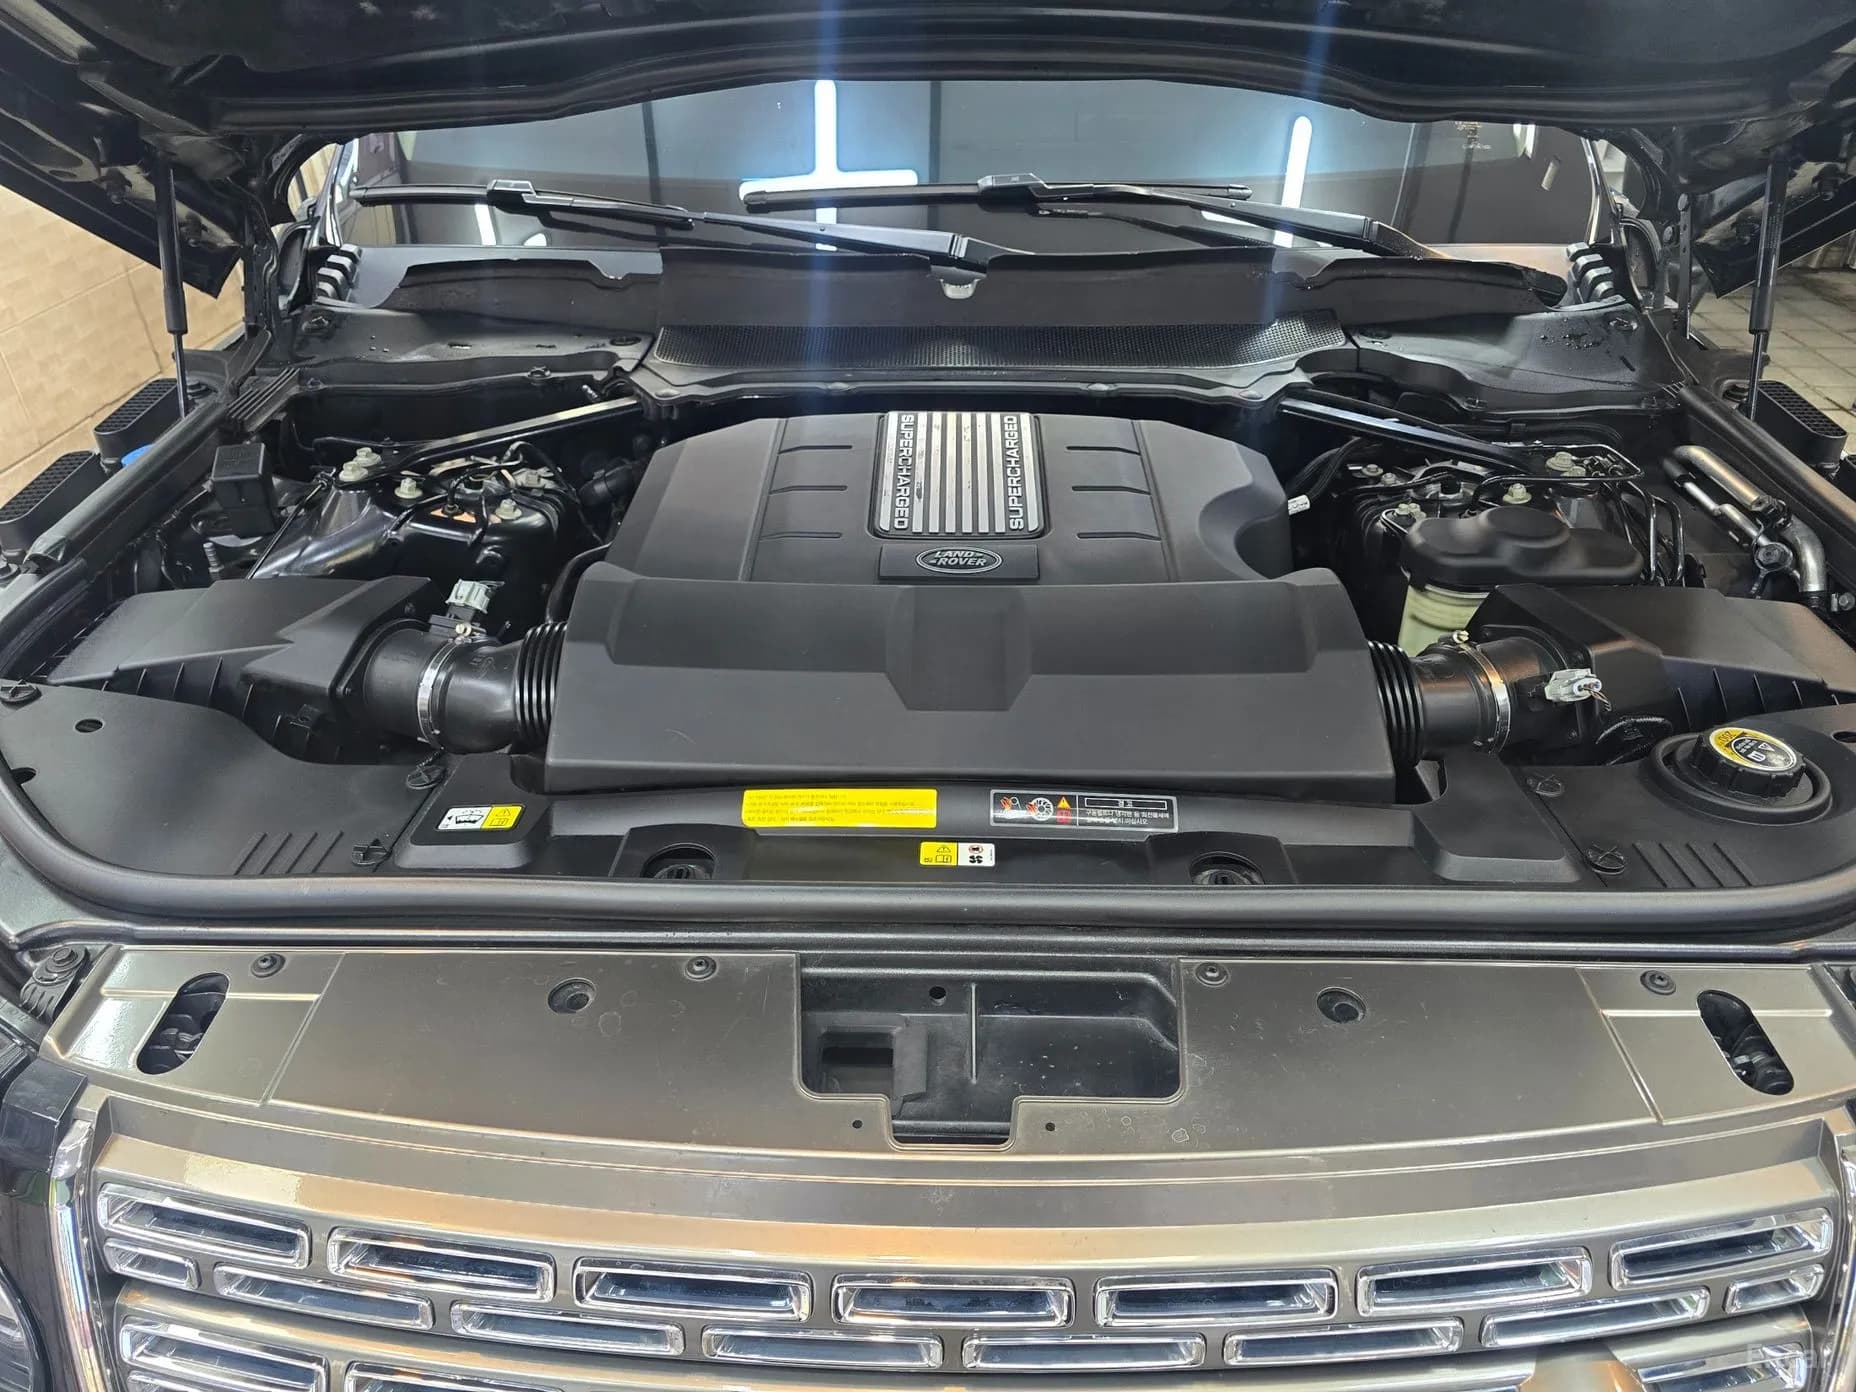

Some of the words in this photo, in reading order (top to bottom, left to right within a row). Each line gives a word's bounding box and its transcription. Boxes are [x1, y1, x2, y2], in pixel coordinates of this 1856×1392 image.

[893, 414, 915, 530] SUPERCHARGED
[1003, 415, 1025, 531] SUPERCHARGED
[934, 550, 975, 559] LAND
[937, 557, 987, 567] ROVER
